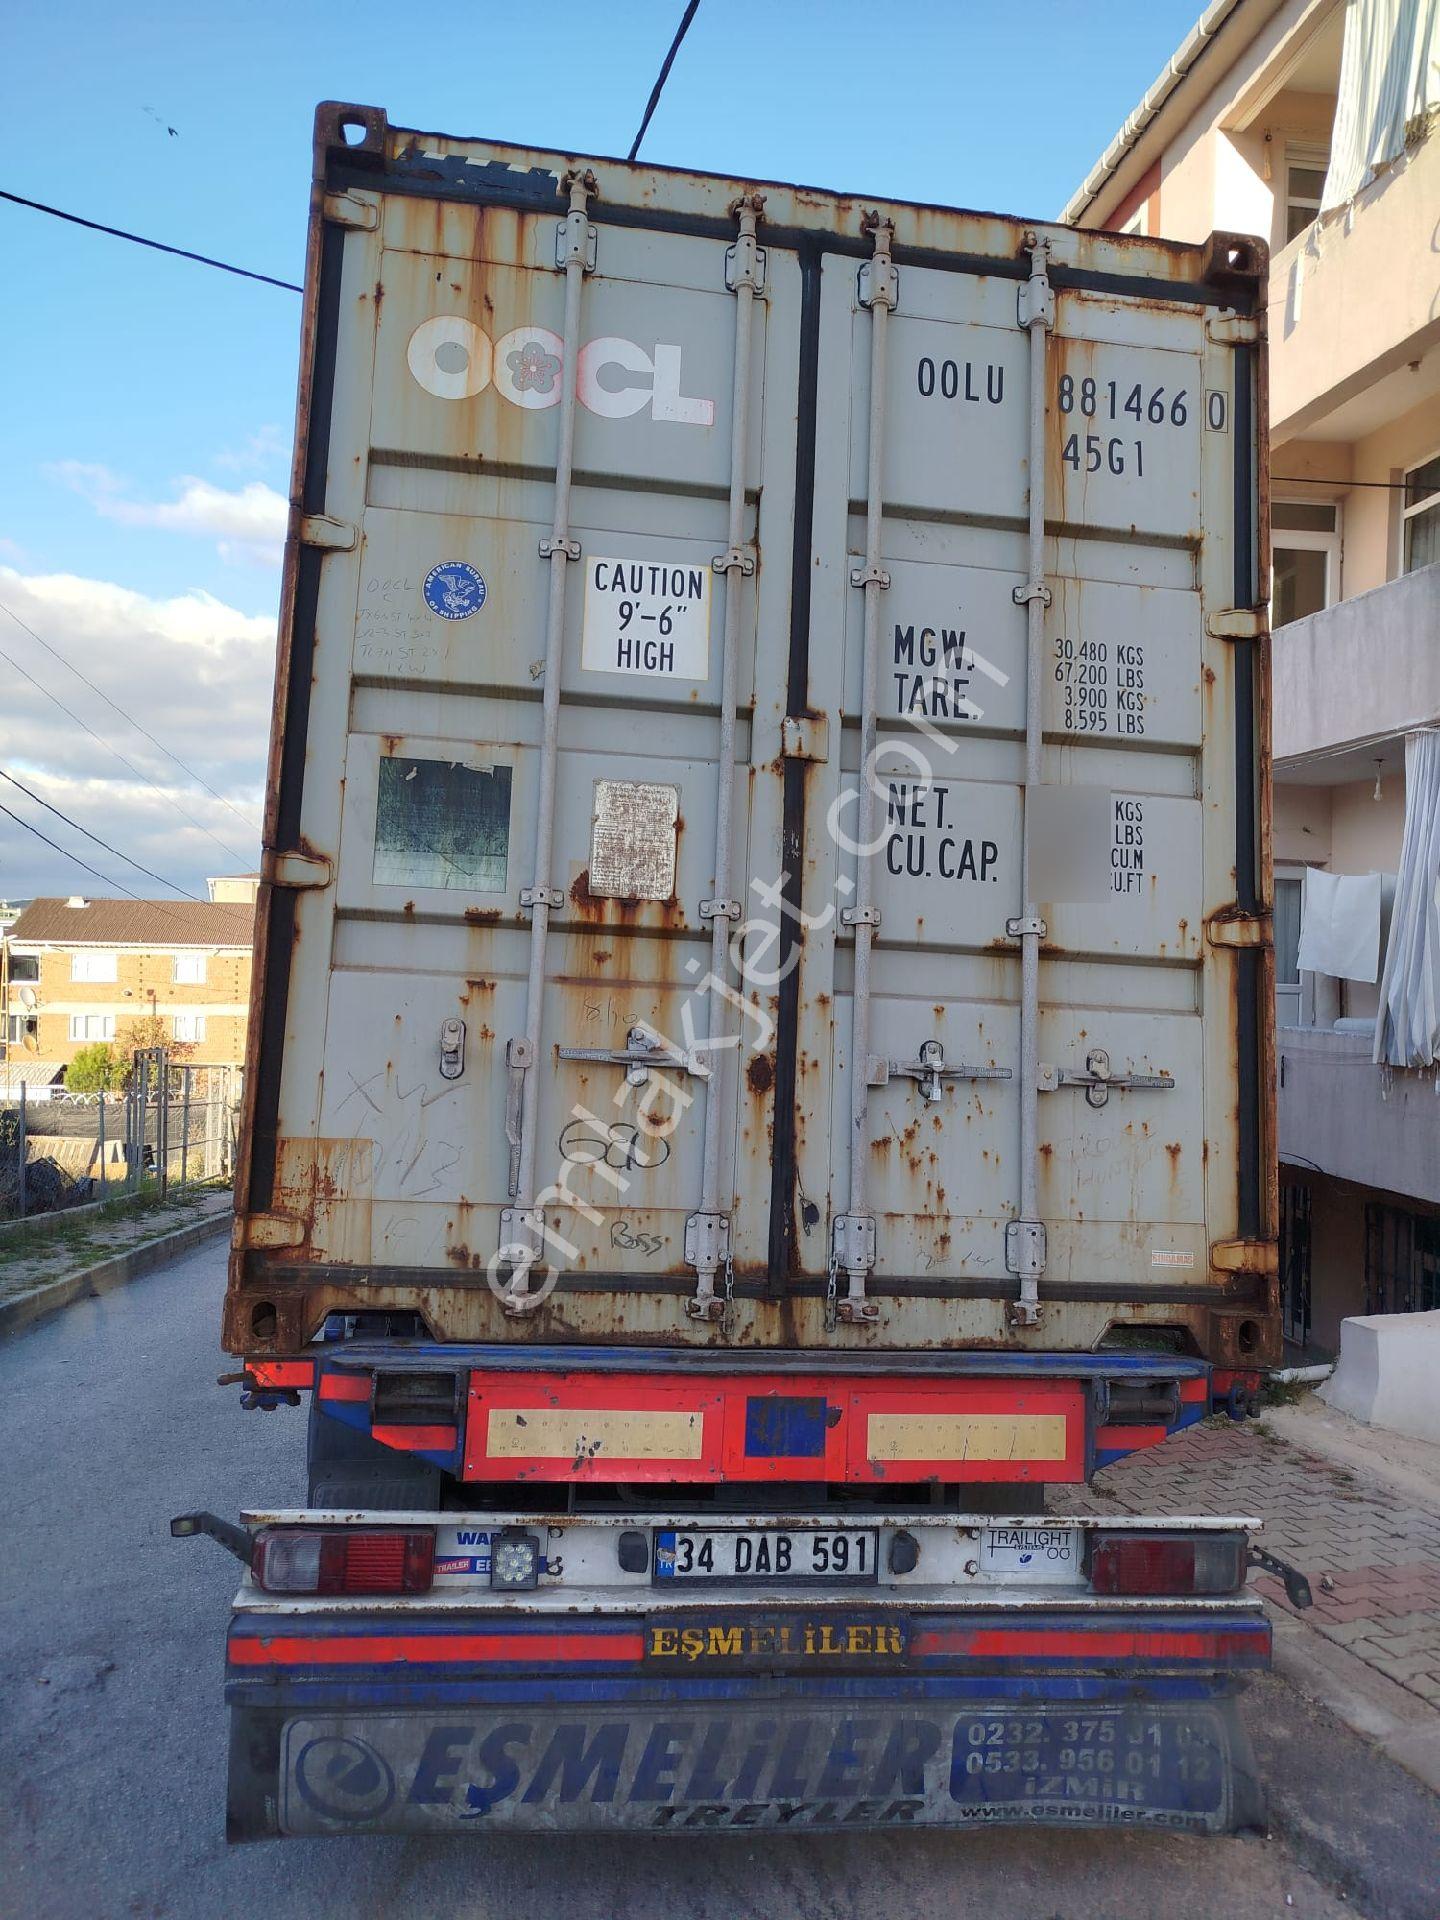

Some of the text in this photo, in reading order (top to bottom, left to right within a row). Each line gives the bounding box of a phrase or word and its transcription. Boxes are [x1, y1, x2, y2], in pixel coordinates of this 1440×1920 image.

[407, 315, 714, 425] OOCL
[917, 357, 1225, 431] OOLU 881466 0
[1062, 433, 1144, 477] 45G1
[425, 562, 485, 595] AMERICAN BUREAU
[594, 563, 703, 600] CAUTION
[439, 605, 478, 620] SHIPPING
[616, 637, 675, 673] HIGH
[1054, 639, 1144, 666] 30,480 KGS
[1054, 663, 1144, 688] 67,200 LBS
[894, 673, 980, 720] TARE.
[1064, 686, 1144, 712] 3,900 KGS
[1064, 710, 1145, 734] 8,595 LBS
[888, 783, 953, 829] NET.
[1115, 801, 1143, 823] KGS
[1115, 825, 1143, 846] LBS
[1111, 871, 1142, 894] U.FT
[988, 1530, 1071, 1551] TRAILIGHT
[437, 1560, 469, 1574] TRAILER
[676, 1538, 714, 1573] 34
[734, 1536, 792, 1573] DAB
[812, 1535, 867, 1572] 591
[1063, 1720, 1115, 1744] 375
[1059, 1748, 1115, 1773] 956
